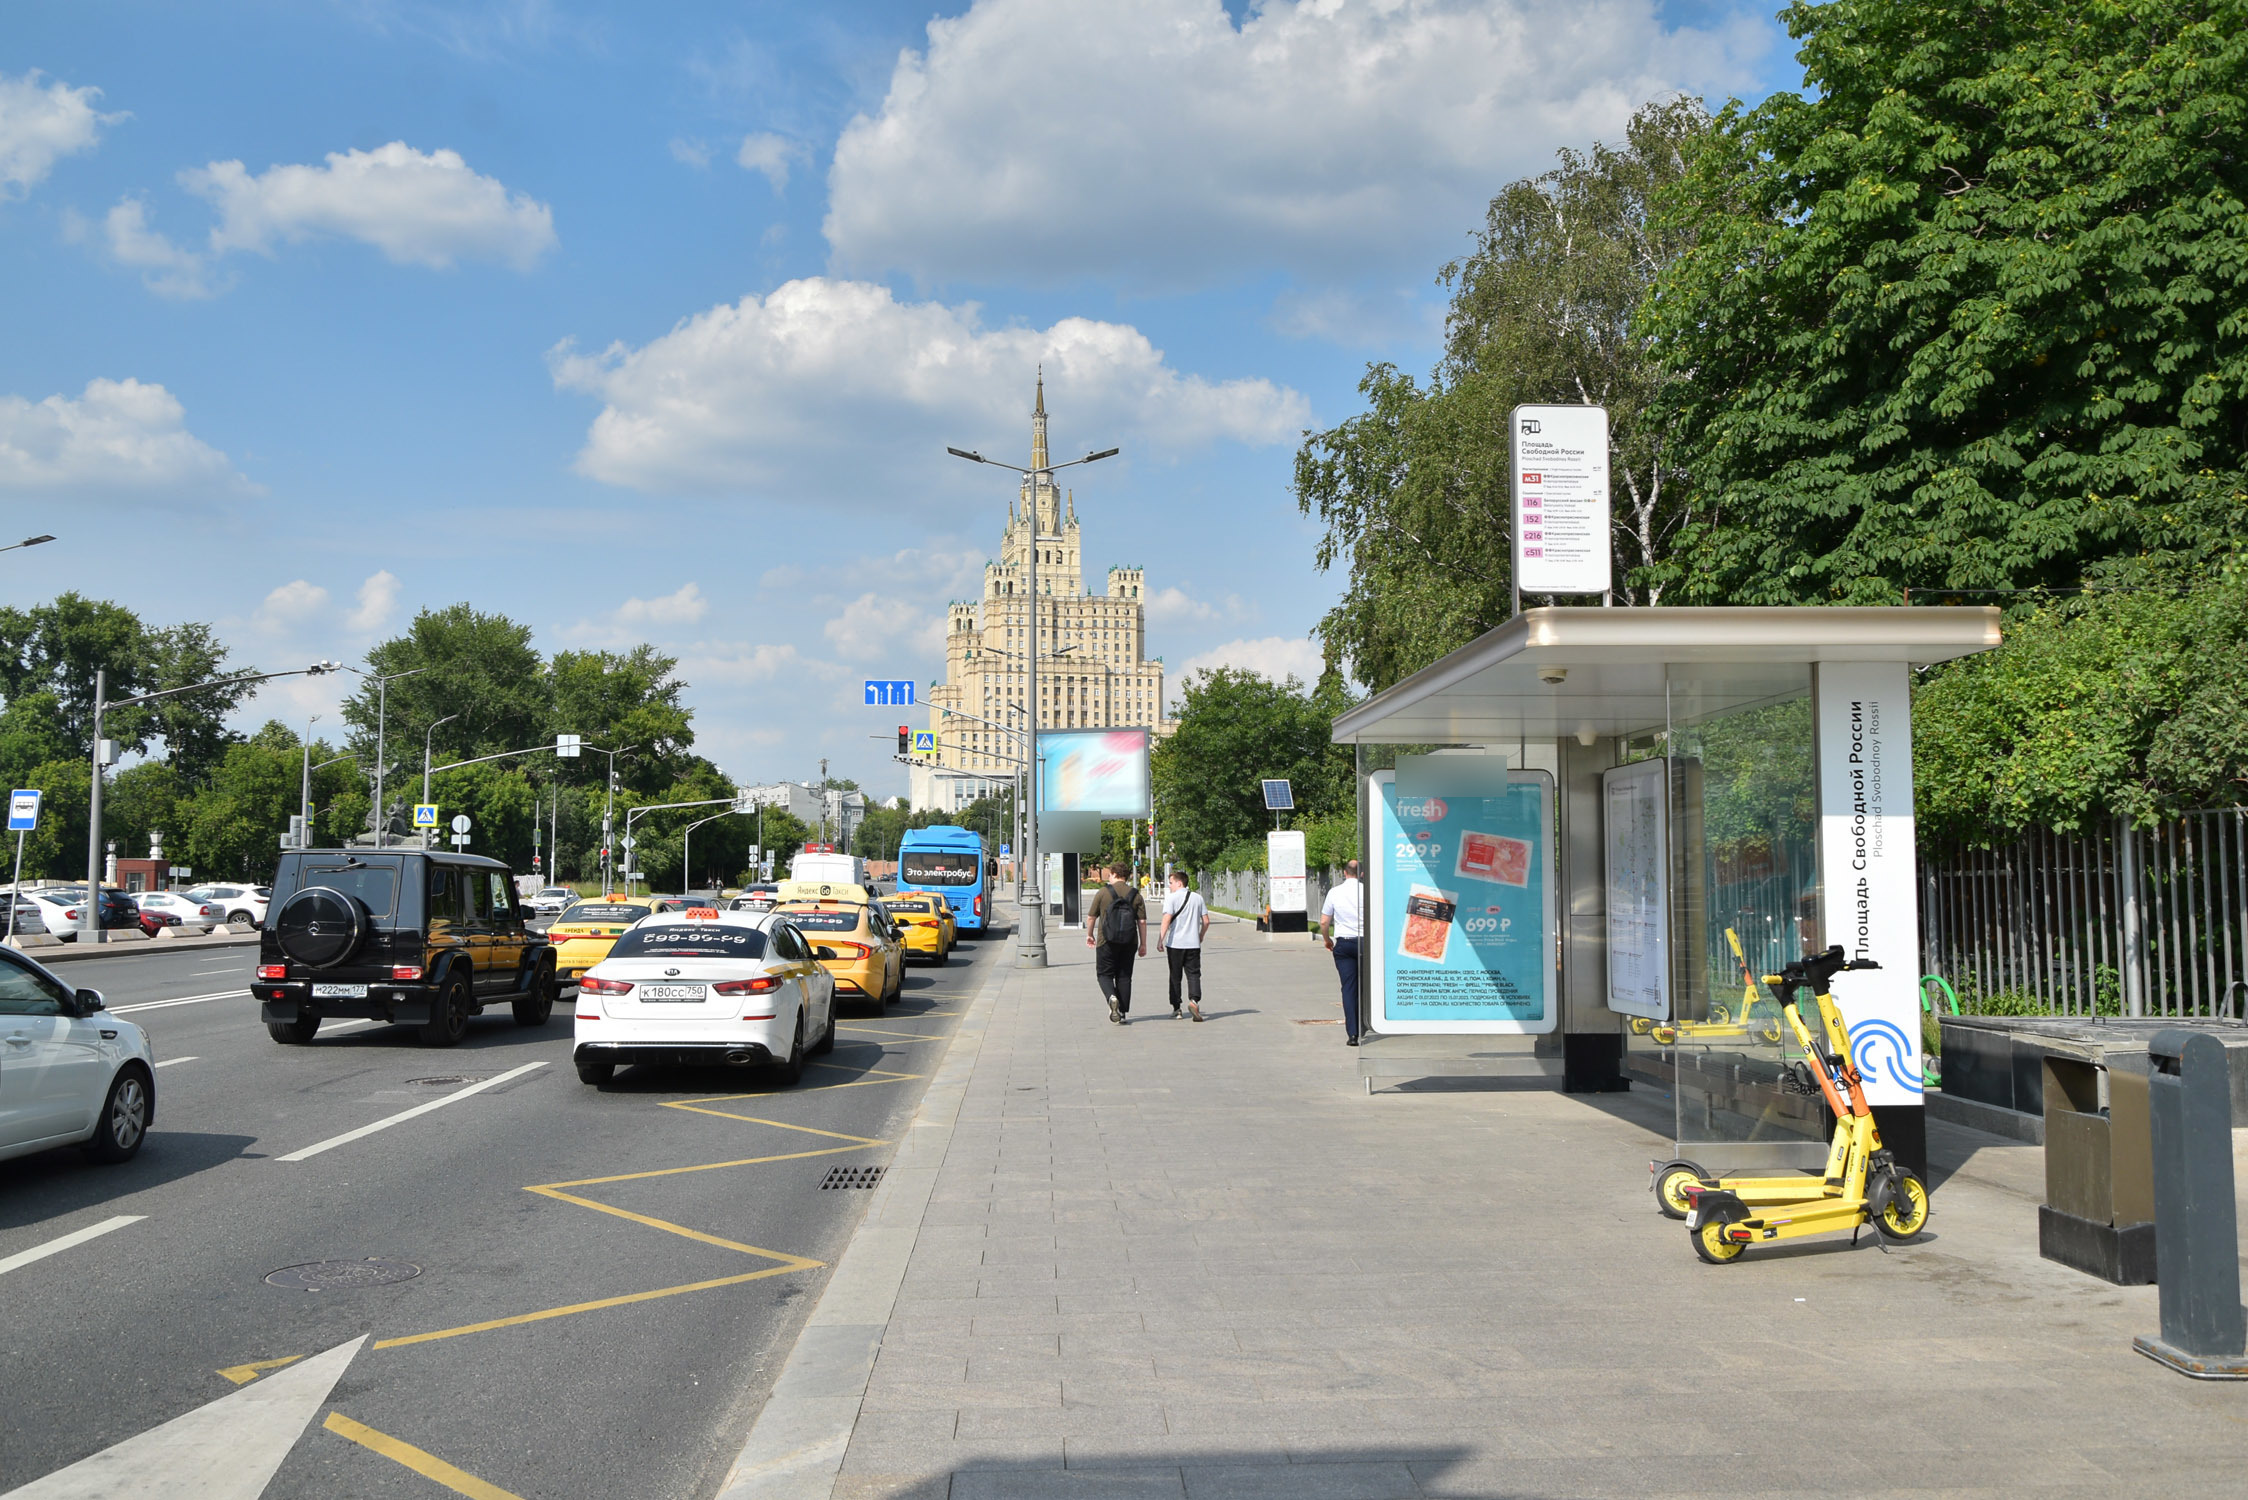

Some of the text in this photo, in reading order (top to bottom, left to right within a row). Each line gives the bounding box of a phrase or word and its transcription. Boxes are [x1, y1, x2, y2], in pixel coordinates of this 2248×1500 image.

[1524, 532, 1542, 540] с216
[1868, 701, 1884, 858] Ploschad Svobodnoy Rossii
[1396, 800, 1442, 817] fresh
[1849, 701, 1869, 961] Площадь Свободной России
[1395, 843, 1442, 858] 299 ₽
[906, 868, 923, 876] Это
[924, 868, 974, 878] электробус.
[797, 885, 818, 895] Яндекс
[821, 886, 830, 895] Go
[1465, 918, 1511, 932] 699 ₽
[315, 985, 366, 995] М222ММ 177
[686, 986, 703, 995] 750
